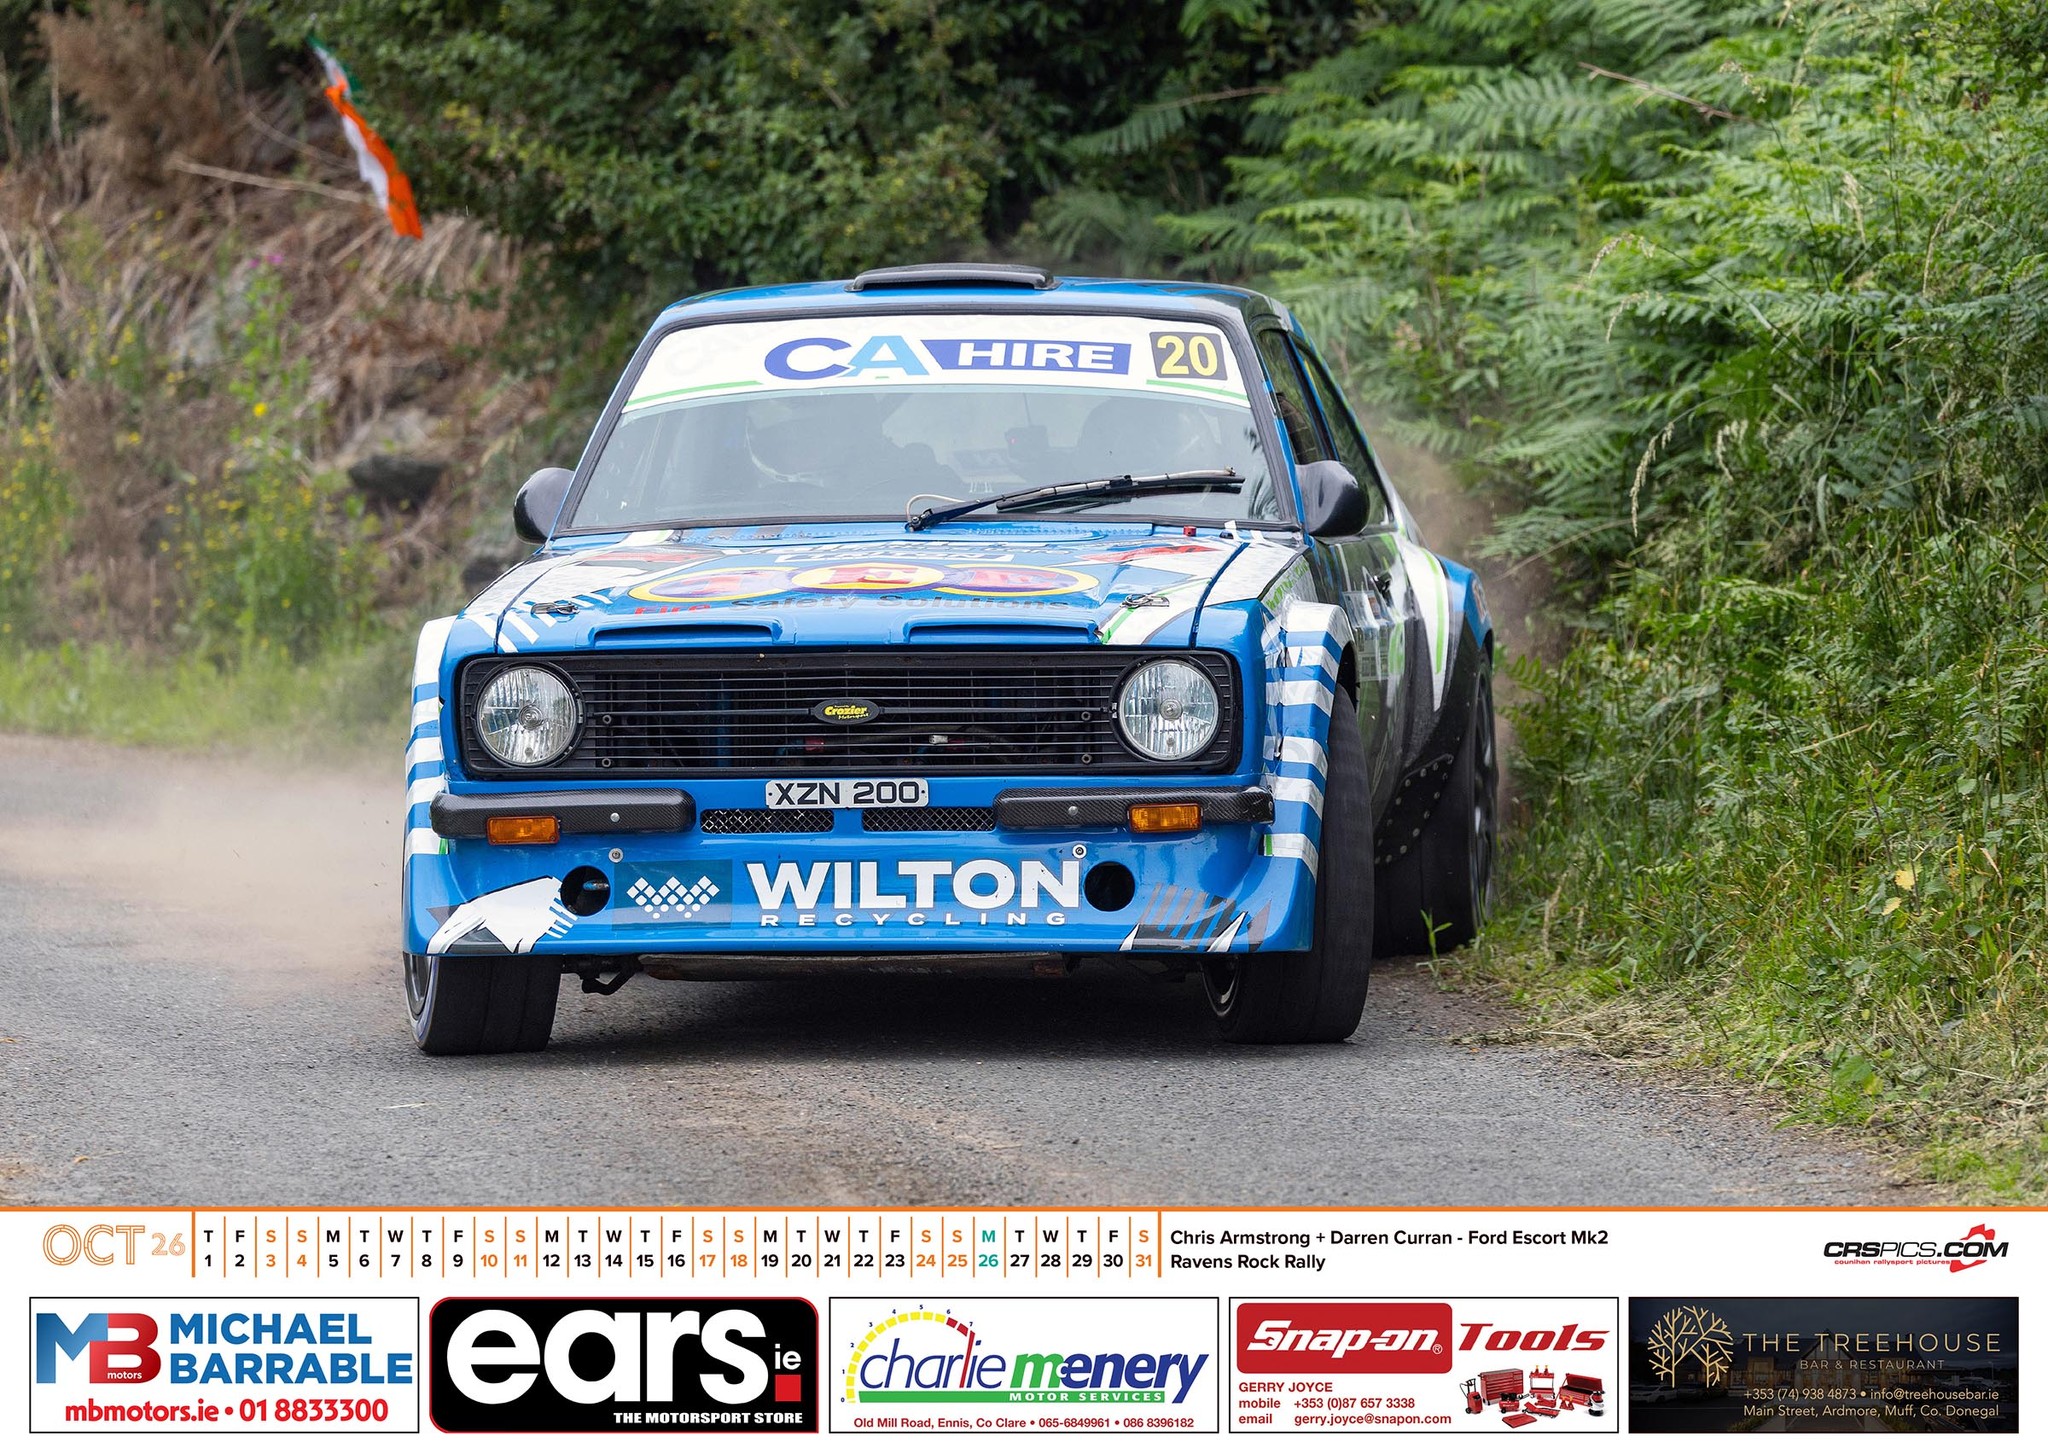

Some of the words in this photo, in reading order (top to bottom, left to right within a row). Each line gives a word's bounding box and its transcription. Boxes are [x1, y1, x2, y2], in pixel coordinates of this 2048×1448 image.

[764, 336, 930, 381] CA
[957, 342, 1114, 370] HIRE
[1156, 335, 1218, 377] 20
[634, 603, 711, 615] Fire
[730, 597, 859, 612] Safety
[876, 594, 1070, 611] Solutions
[824, 705, 868, 716] Crozier
[775, 782, 841, 806] XZN
[853, 781, 920, 804] 200
[745, 859, 1081, 910] WILTON
[760, 912, 1067, 926] RECYCLING
